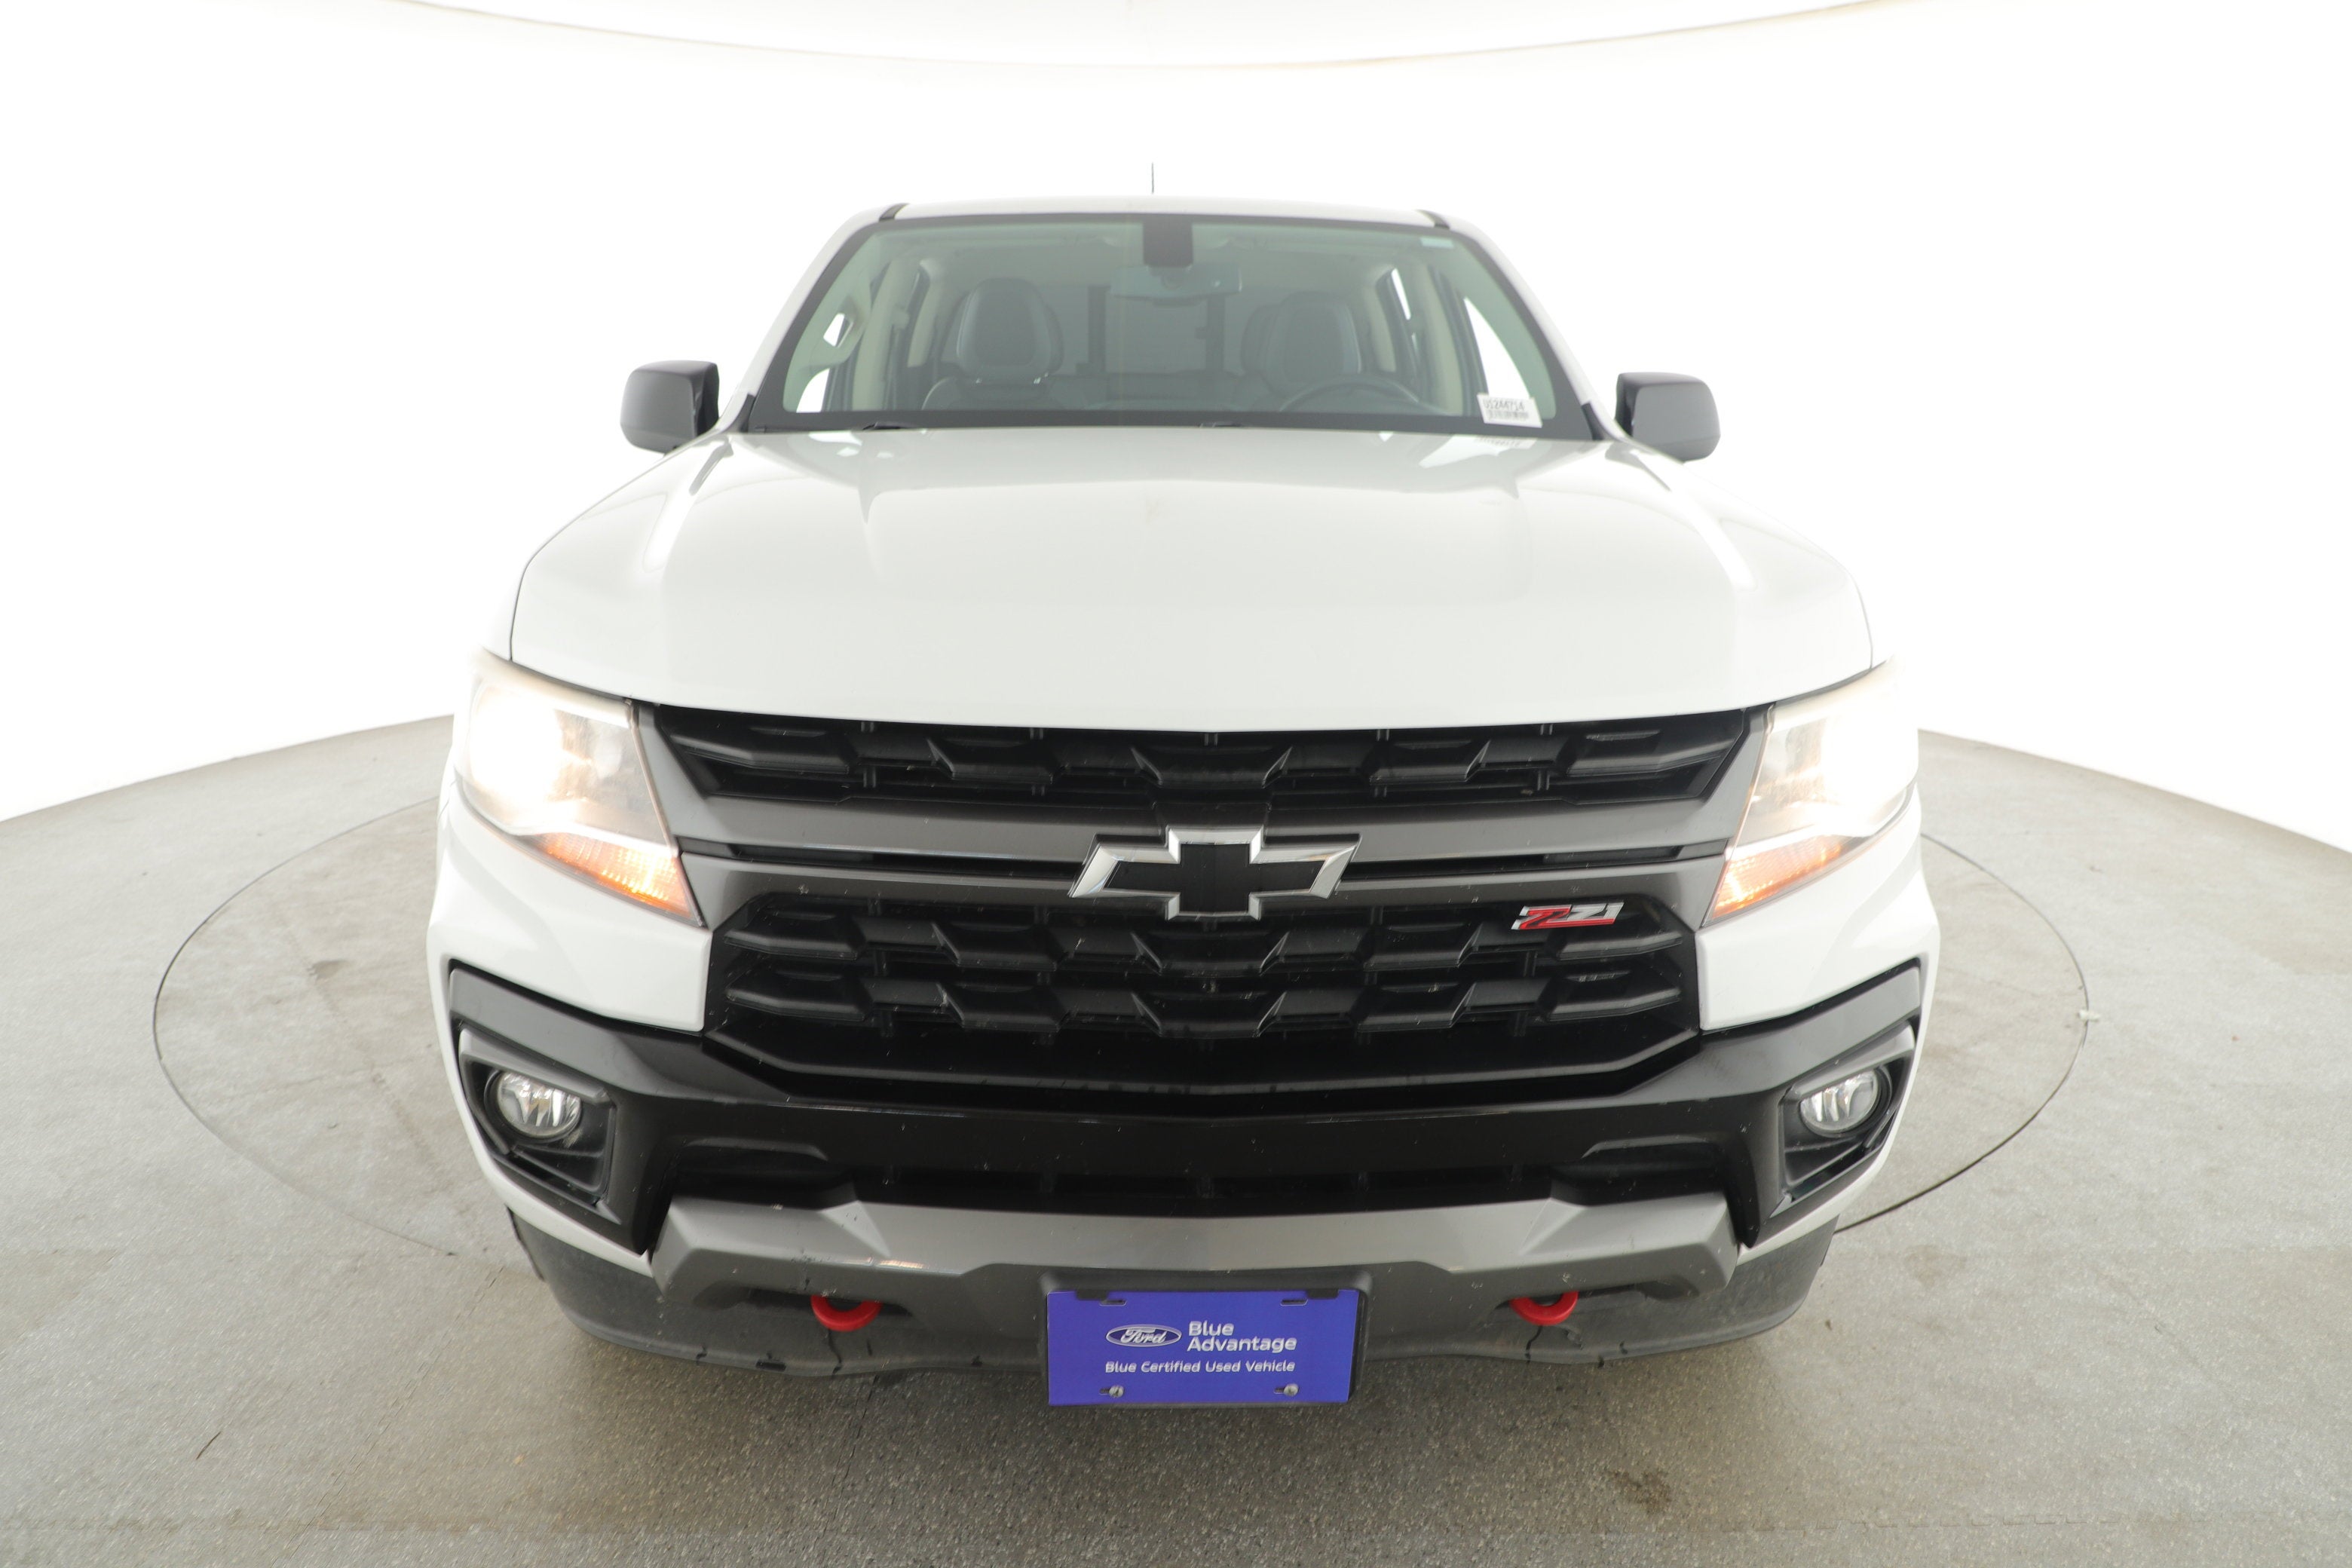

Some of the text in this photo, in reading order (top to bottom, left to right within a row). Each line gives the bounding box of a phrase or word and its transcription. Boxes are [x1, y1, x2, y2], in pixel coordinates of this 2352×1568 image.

[1511, 902, 1624, 929] Z71
[1120, 1328, 1167, 1344] Ford
[1189, 1321, 1234, 1336] Blue
[1187, 1337, 1297, 1353] Advantage
[1105, 1359, 1295, 1373] Blue Certified Used Vehicle
